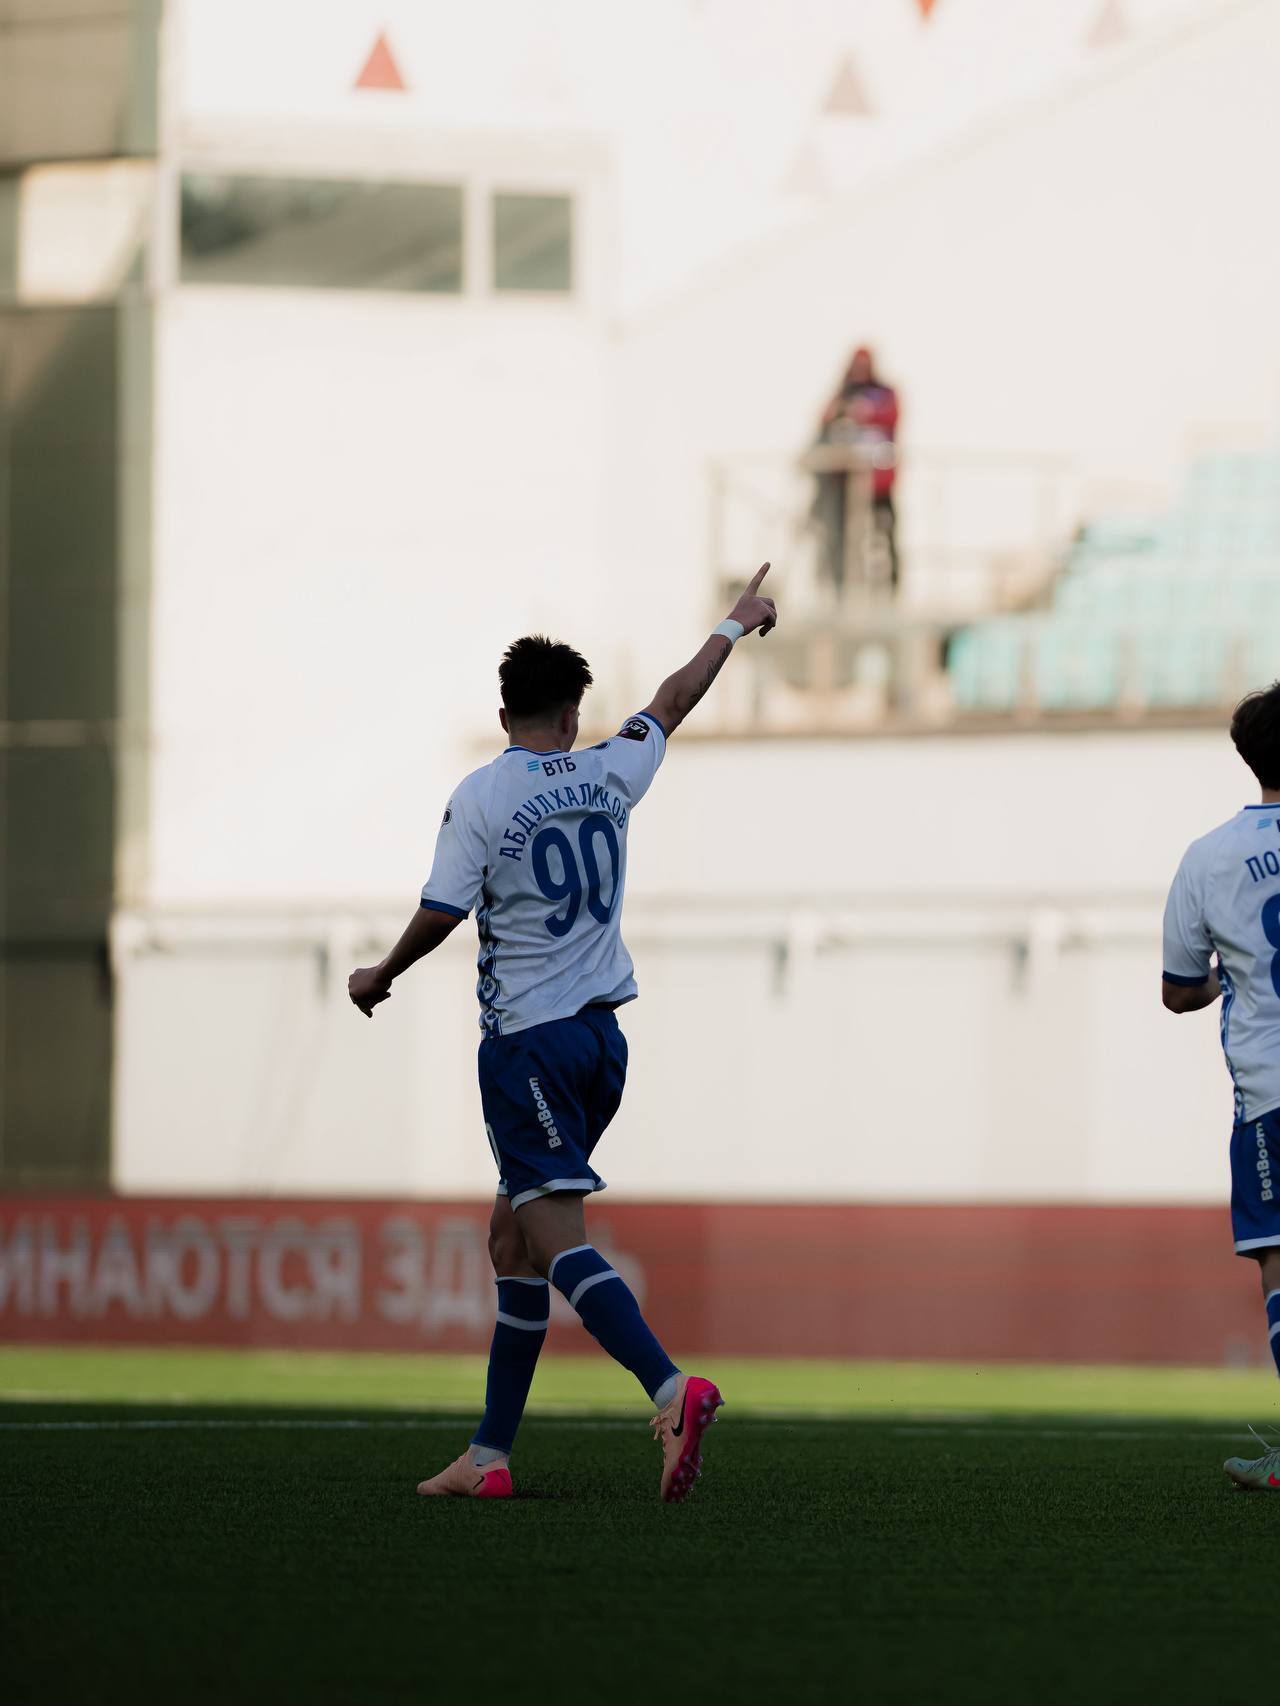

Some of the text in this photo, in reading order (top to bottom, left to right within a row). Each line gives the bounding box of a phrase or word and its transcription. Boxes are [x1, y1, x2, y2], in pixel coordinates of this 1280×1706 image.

[542, 756, 577, 777] ВТБ
[531, 813, 620, 937] 90
[528, 1077, 562, 1149] BetBoom
[1255, 1122, 1274, 1201] BetBoom
